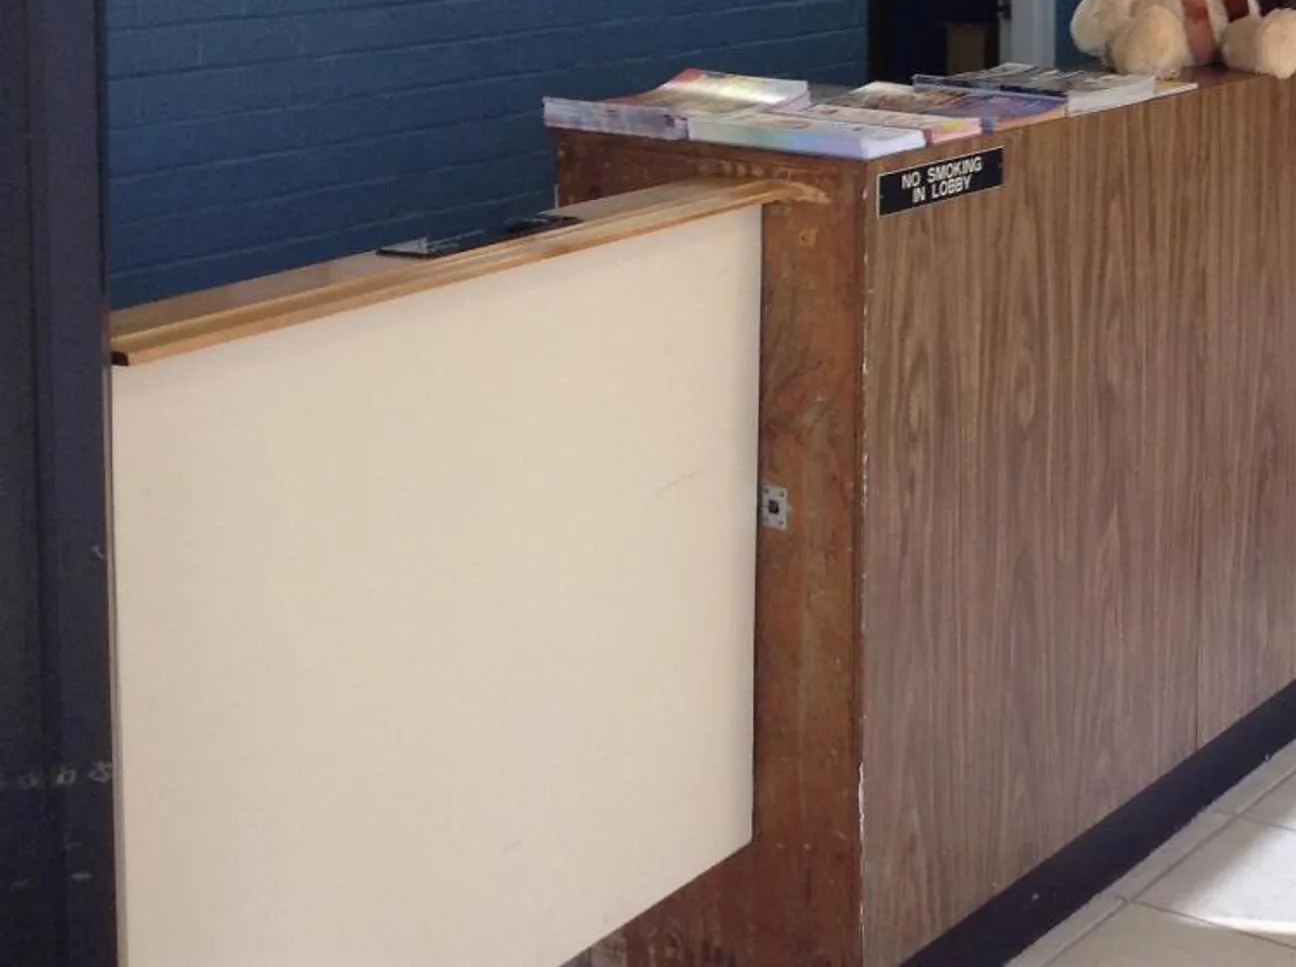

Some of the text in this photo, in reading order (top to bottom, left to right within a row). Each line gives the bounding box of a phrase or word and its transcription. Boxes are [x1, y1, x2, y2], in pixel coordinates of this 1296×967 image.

[902, 156, 982, 190] NO SMOKING
[912, 174, 972, 203] IN LOBBY
